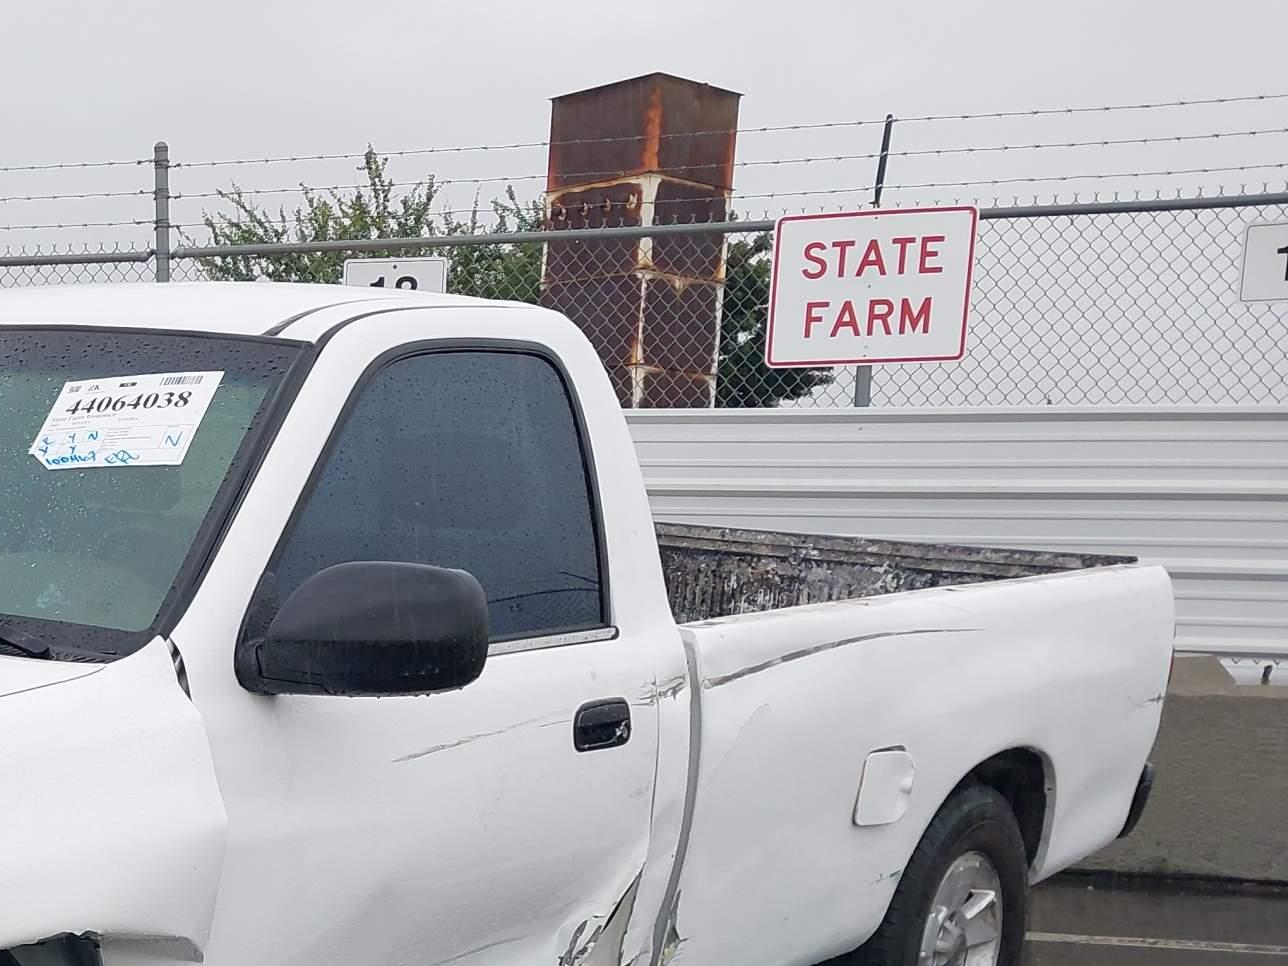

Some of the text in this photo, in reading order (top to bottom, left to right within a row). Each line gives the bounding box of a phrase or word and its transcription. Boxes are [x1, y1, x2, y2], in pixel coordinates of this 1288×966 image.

[801, 235, 946, 280] STATE
[803, 296, 933, 339] FARM
[65, 390, 193, 415] 44064038
[165, 430, 184, 447] N
